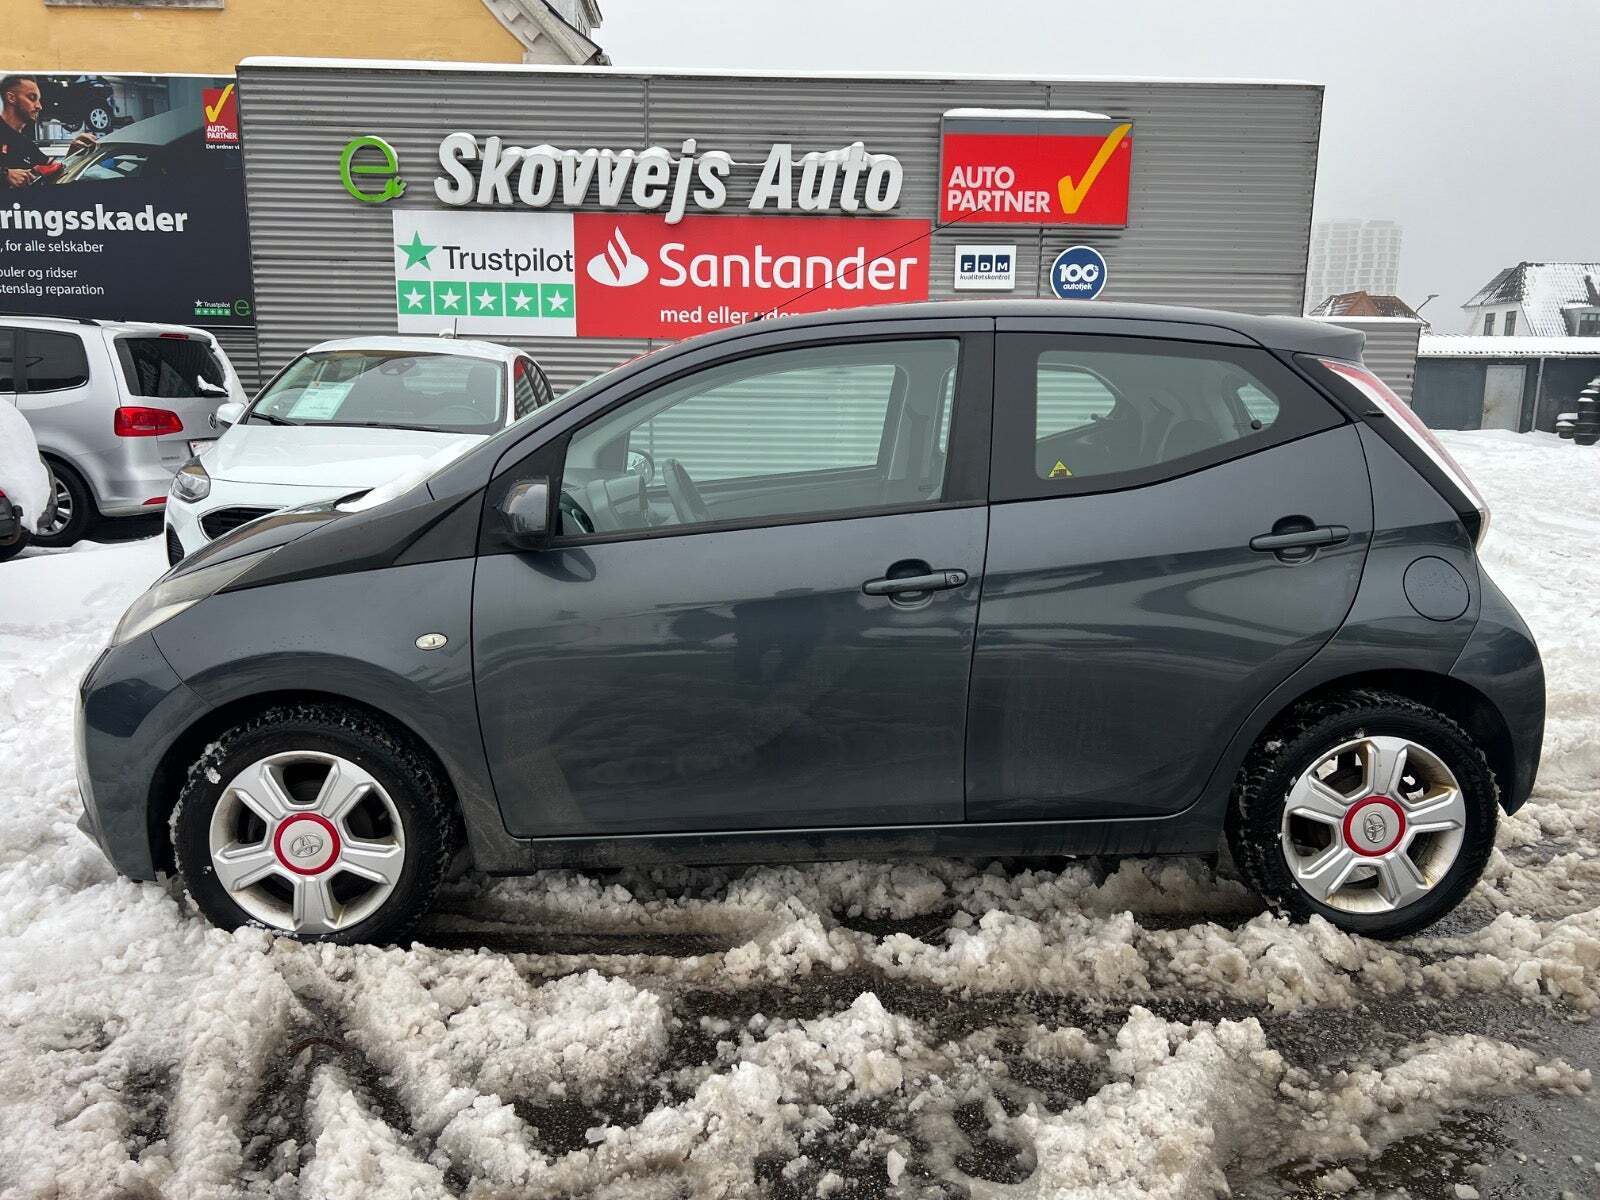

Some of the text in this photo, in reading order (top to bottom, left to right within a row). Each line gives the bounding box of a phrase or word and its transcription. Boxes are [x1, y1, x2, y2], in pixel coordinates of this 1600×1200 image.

[434, 132, 904, 225] Skovvejs Auto
[948, 166, 1015, 189] AUTO
[947, 190, 1050, 213] PARTNER
[0, 202, 188, 237] ringsskader
[5, 240, 22, 252] for
[25, 240, 46, 252] alle
[48, 241, 104, 253] selskaber
[442, 246, 574, 276] Trustpilot
[659, 243, 918, 291] Santander
[963, 260, 1010, 271] FDM
[28, 270, 42, 280] og
[46, 267, 78, 279] ridser
[46, 284, 105, 297] reparation
[1062, 283, 1092, 291] autotjek
[660, 306, 702, 323] med
[707, 306, 750, 325] eller
